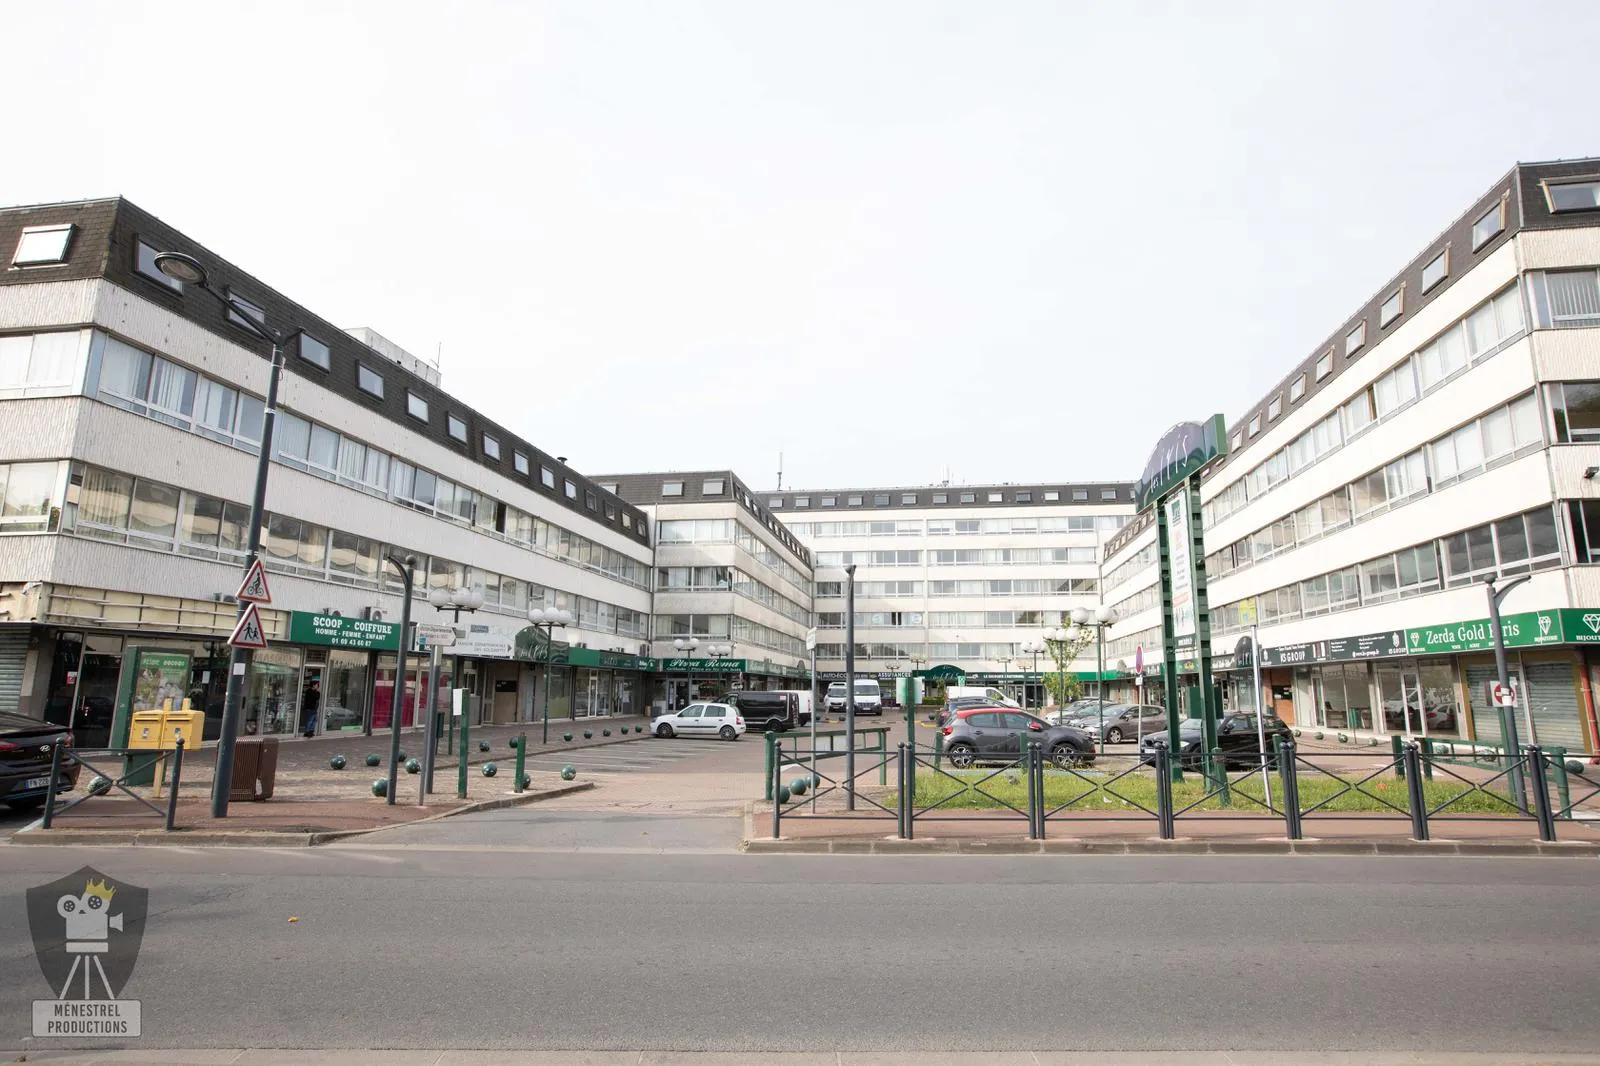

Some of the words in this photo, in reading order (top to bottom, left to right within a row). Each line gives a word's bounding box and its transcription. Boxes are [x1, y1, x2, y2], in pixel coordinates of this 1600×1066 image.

[1160, 432, 1189, 487] iris
[313, 616, 342, 628] SCOOP
[354, 621, 392, 634] COIFFURE
[315, 627, 337, 636] HOMME
[342, 630, 362, 638] FEMME
[366, 632, 386, 641] ENFANT
[1425, 632, 1455, 645] Zerda
[1457, 623, 1486, 642] Gold
[704, 659, 741, 668] Roma
[1286, 650, 1306, 662] GROUP
